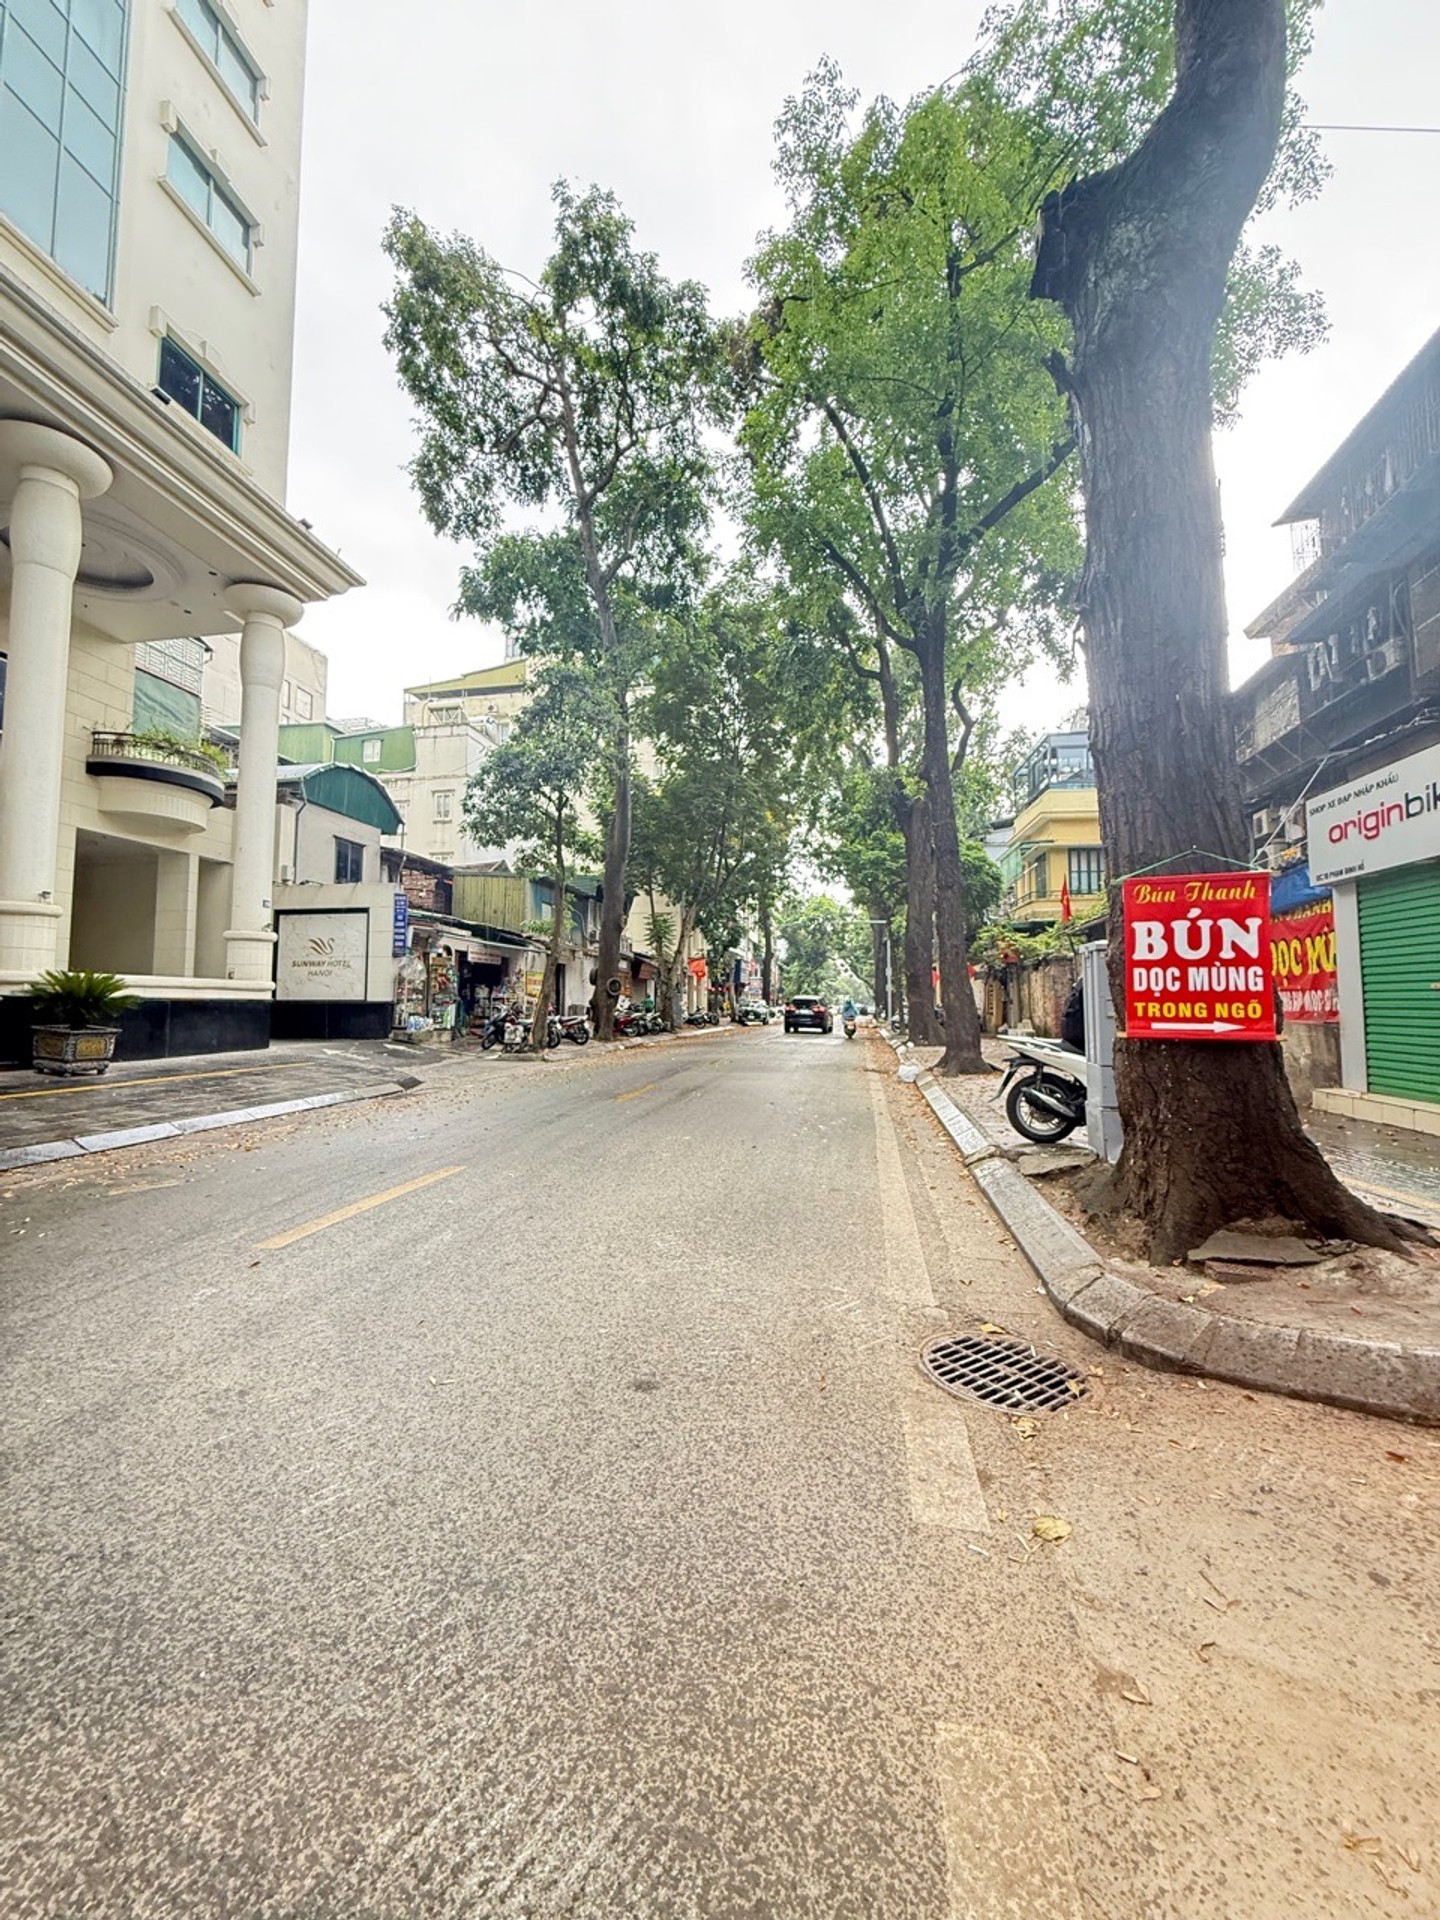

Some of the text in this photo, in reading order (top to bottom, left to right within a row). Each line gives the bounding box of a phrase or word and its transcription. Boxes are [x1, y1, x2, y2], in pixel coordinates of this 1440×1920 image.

[1309, 803, 1327, 817] SHOP
[1327, 799, 1337, 810] XE
[1184, 879, 1257, 902] Thanh
[1131, 907, 1262, 961] BÚN
[291, 960, 352, 968] SUNWAY HOTEL
[1132, 961, 1264, 997] DỌC MÙNG
[1134, 1002, 1208, 1019] TRONG
[1215, 999, 1262, 1019] NGÕ
